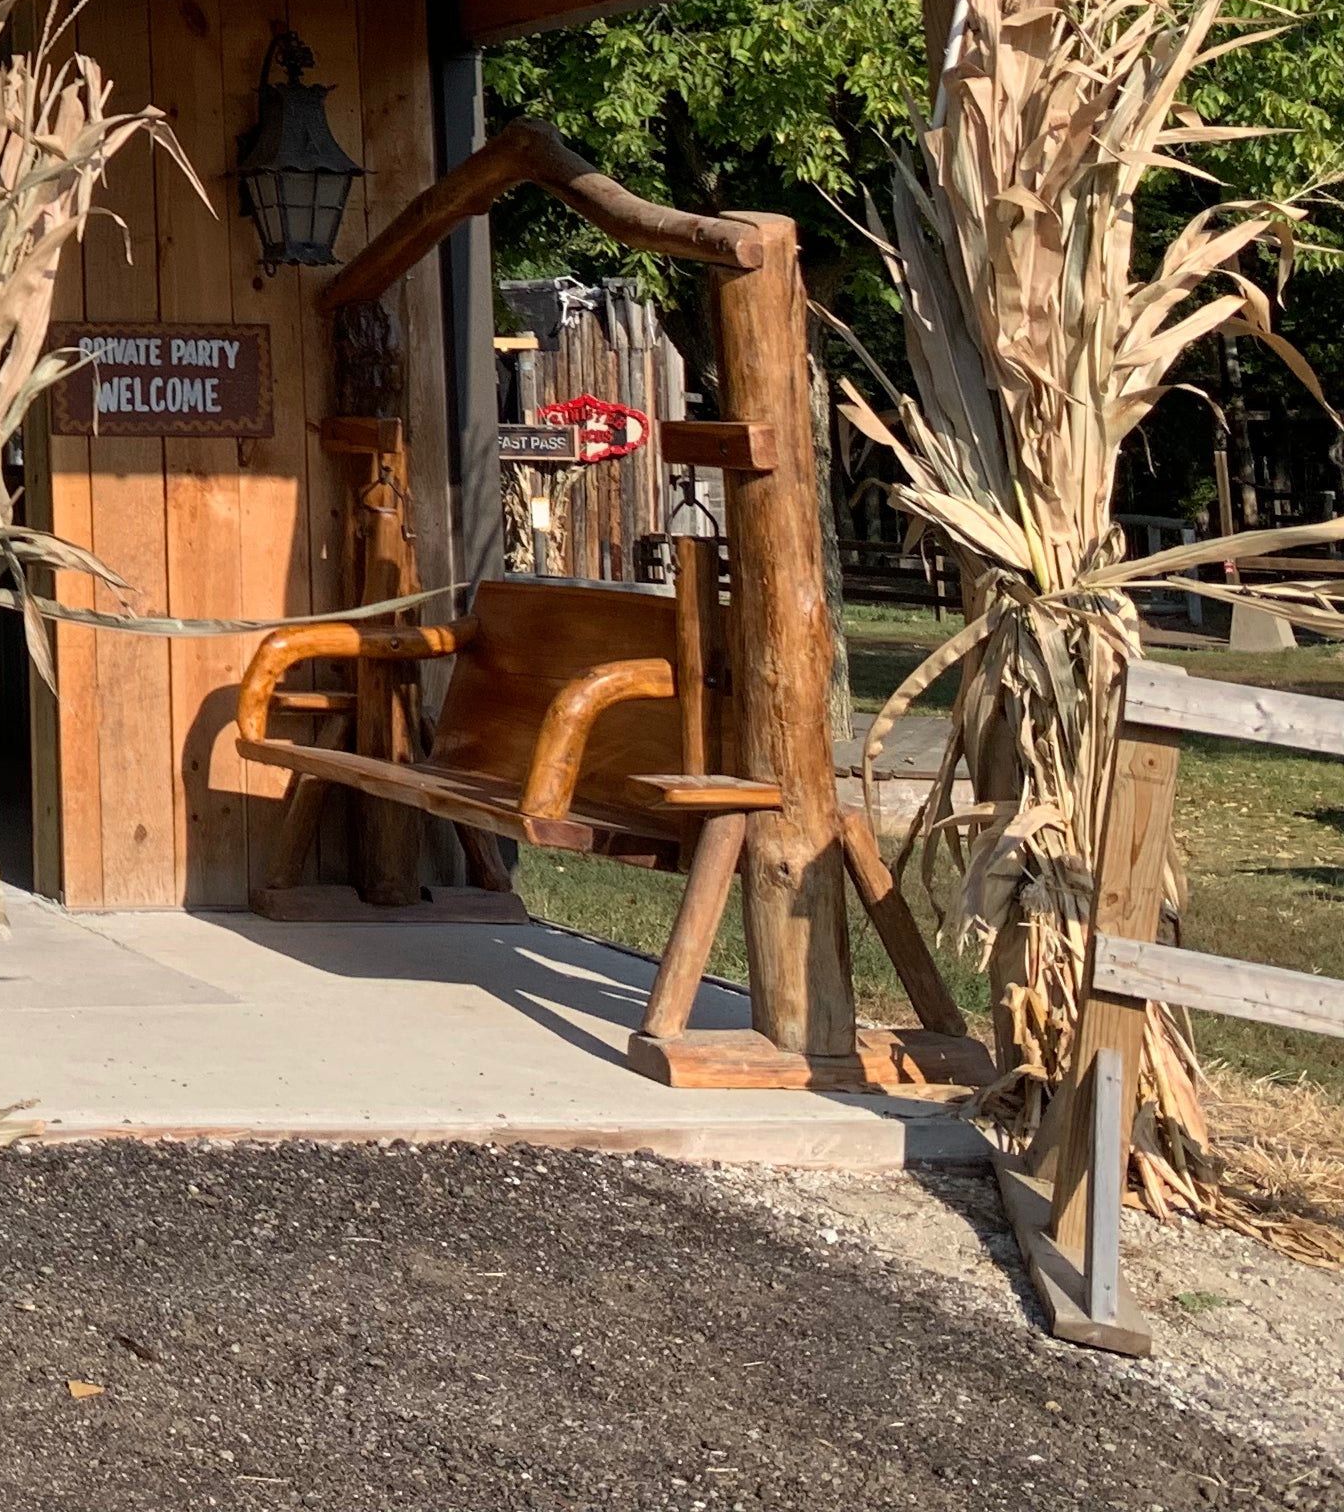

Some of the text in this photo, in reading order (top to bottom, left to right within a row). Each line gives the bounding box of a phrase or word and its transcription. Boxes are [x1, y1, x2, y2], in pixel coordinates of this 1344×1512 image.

[79, 336, 240, 370] PRIVATE PARTY
[93, 376, 223, 413] WELCOME
[498, 436, 567, 450] FAST PASS
